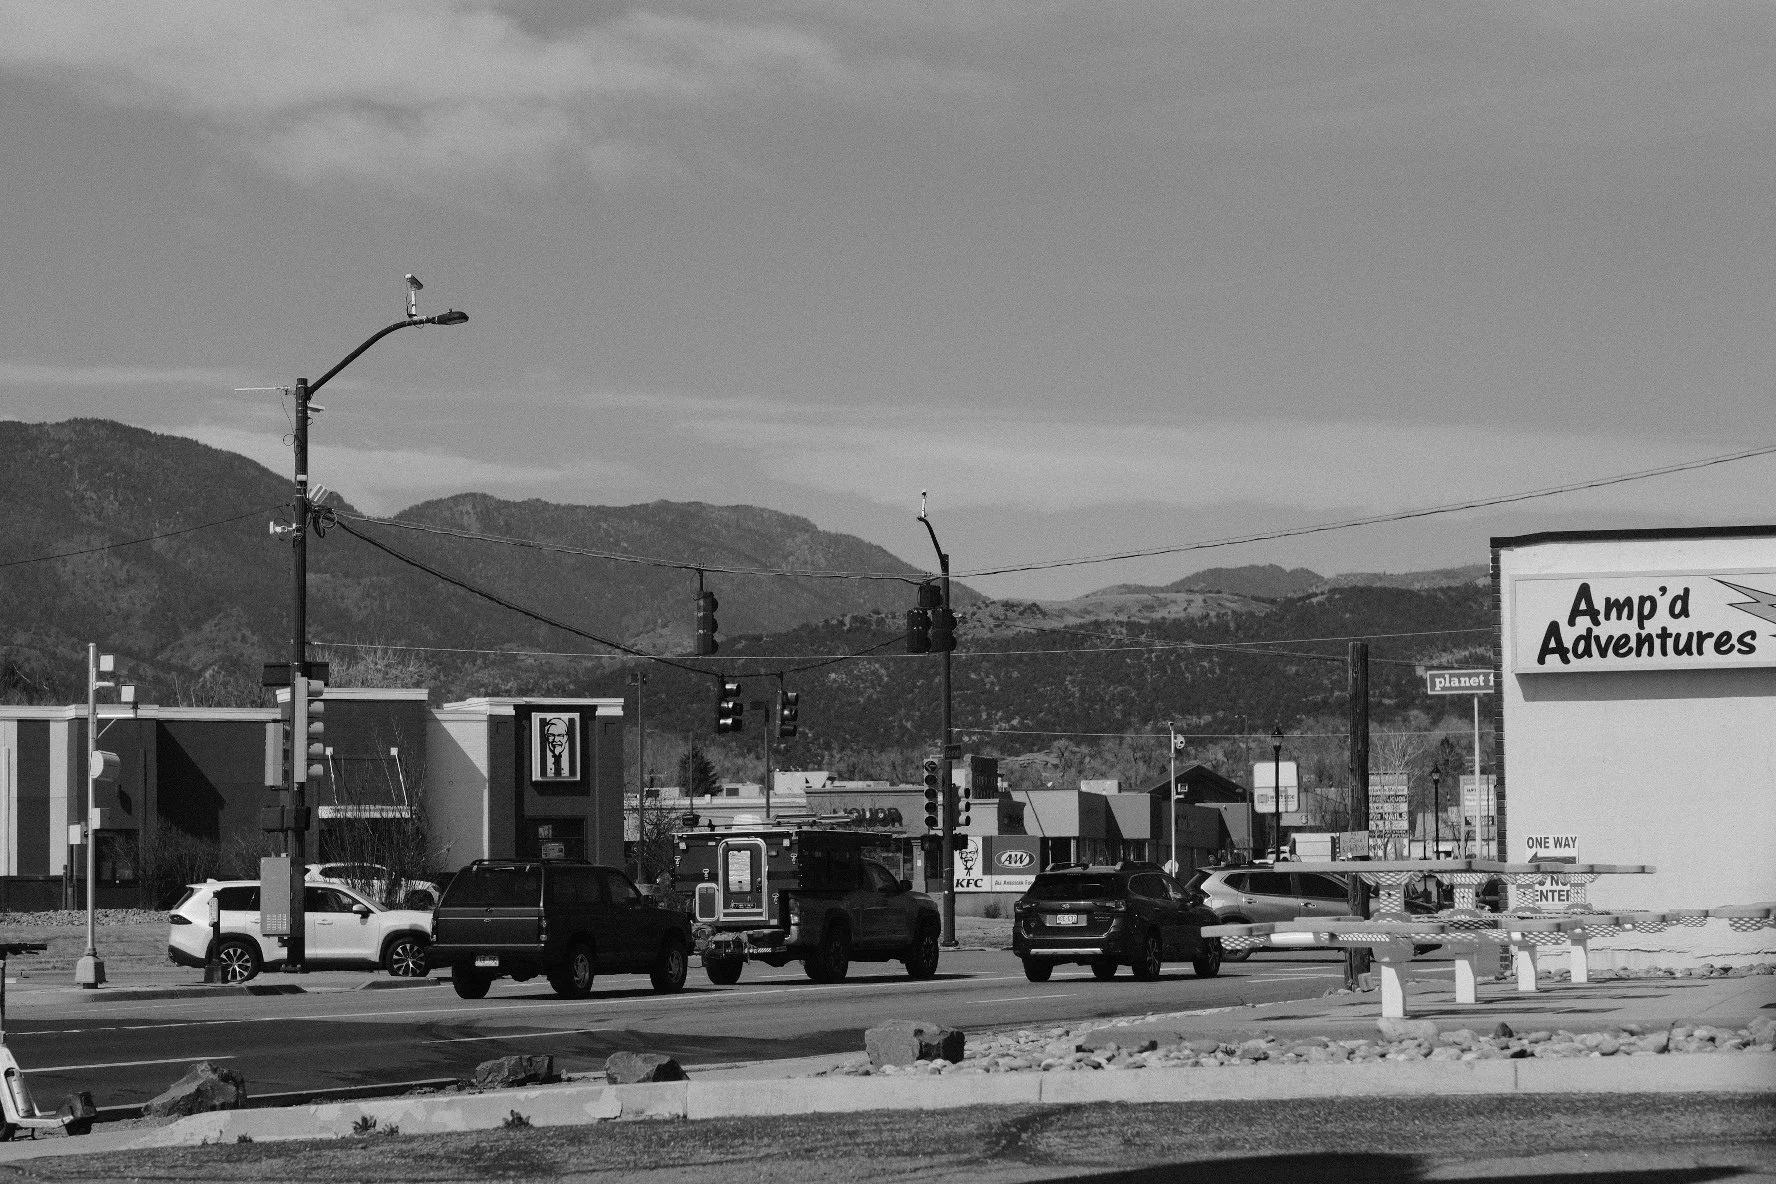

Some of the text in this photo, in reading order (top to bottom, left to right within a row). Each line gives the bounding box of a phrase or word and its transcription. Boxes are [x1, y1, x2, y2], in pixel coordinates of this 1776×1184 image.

[1568, 583, 1690, 630] Amp'd
[1537, 621, 1756, 665] Adventures
[1435, 674, 1485, 690] planet
[1527, 836, 1577, 849] ONE WAY
[955, 878, 983, 888] KFC
